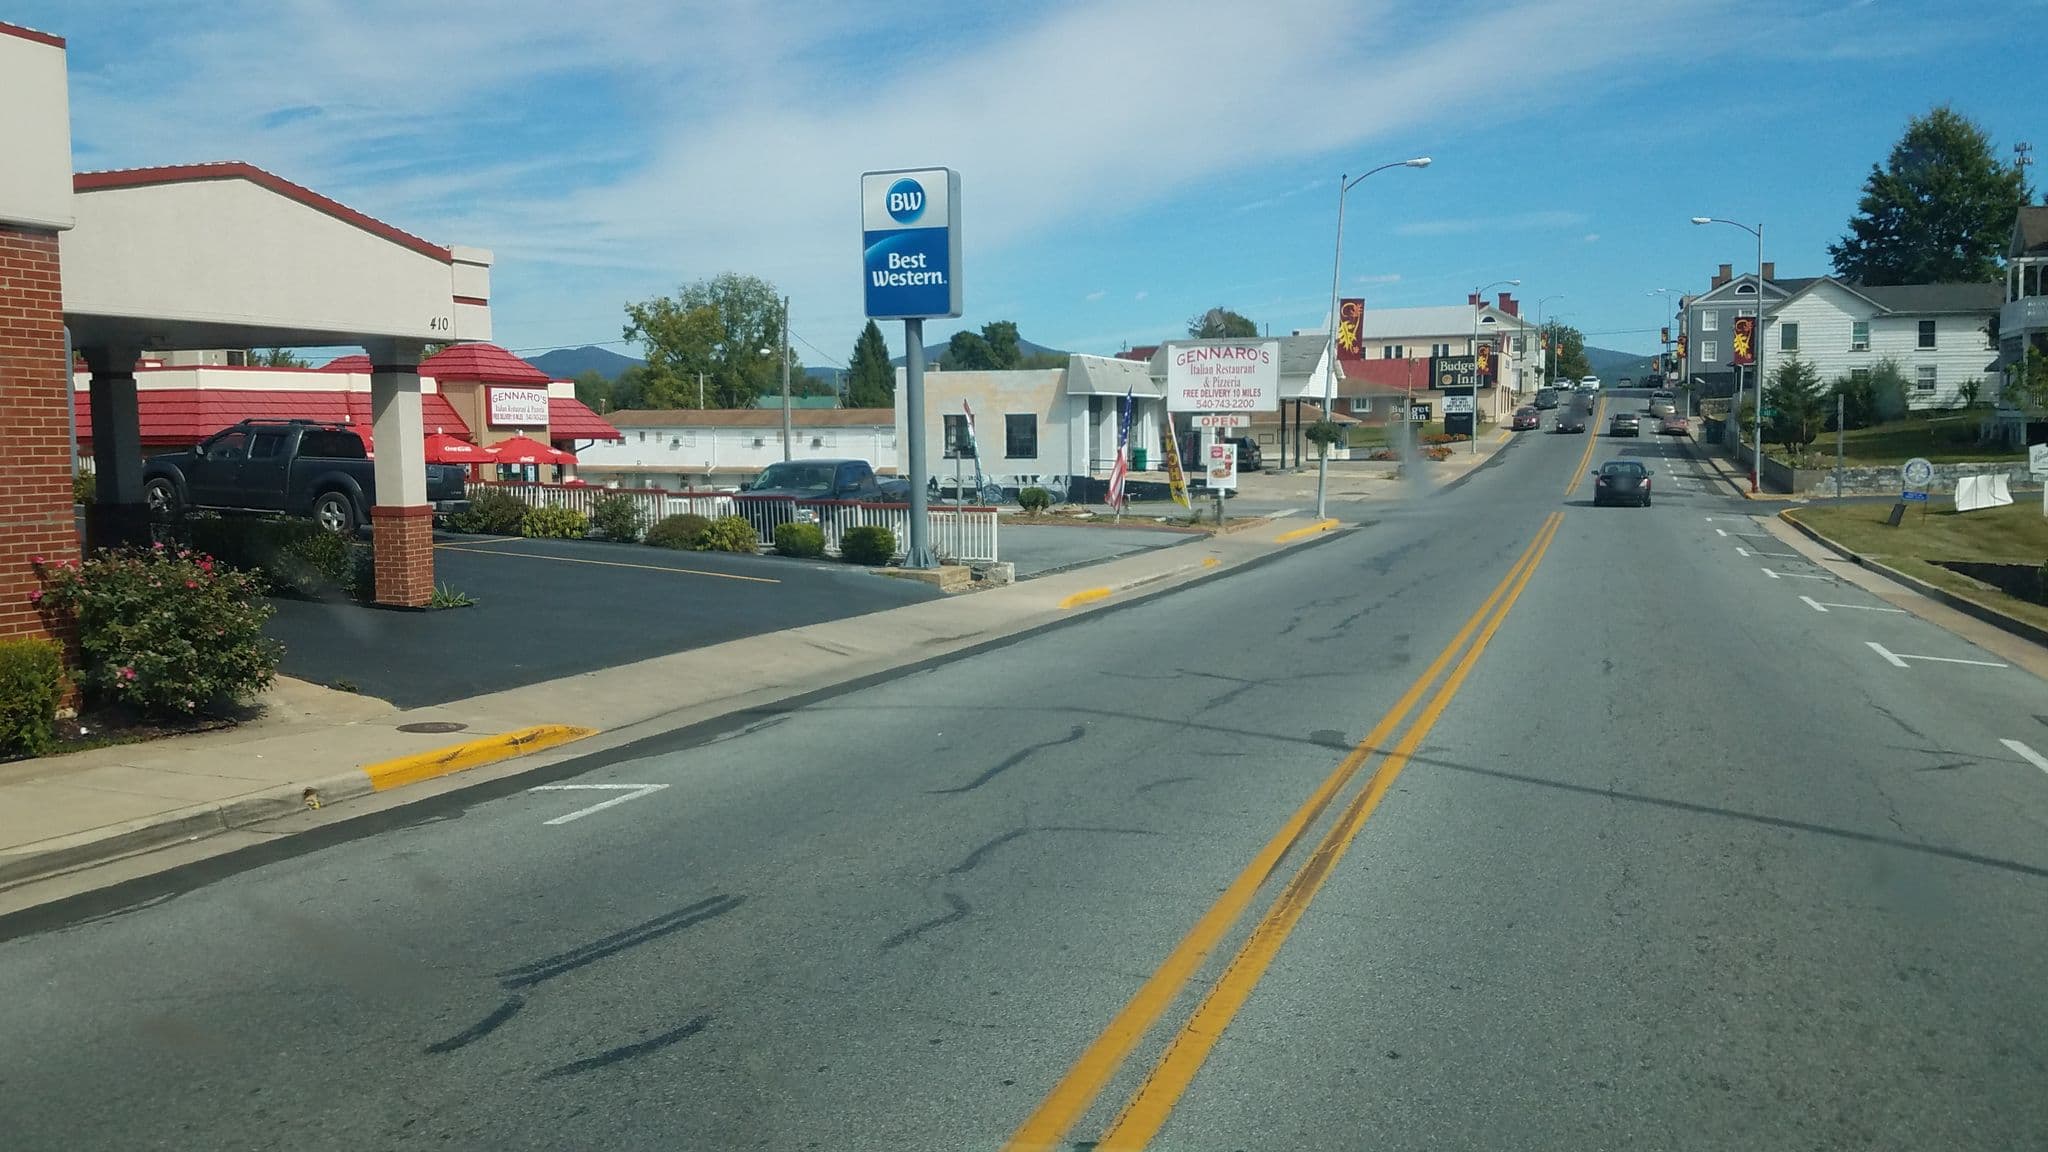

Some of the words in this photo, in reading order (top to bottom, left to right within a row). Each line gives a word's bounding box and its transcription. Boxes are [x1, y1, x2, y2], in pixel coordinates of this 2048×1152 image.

[890, 192, 922, 212] BW
[888, 253, 926, 269] Best
[872, 271, 943, 287] Western
[430, 317, 449, 331] 410
[1176, 346, 1270, 366] GENNARO'S
[1190, 364, 1214, 375] Italian
[1216, 364, 1256, 375] Restaurant
[1440, 360, 1475, 374] Budge
[1203, 378, 1210, 388] &
[1213, 376, 1241, 388] Pizzeria
[492, 391, 547, 405] GENNARO'S
[1183, 389, 1199, 398] FREE
[1200, 389, 1231, 398] DELIVERY
[1233, 389, 1241, 397] 10
[1242, 388, 1262, 397] MILES
[1196, 400, 1255, 409] 540-743-2200
[1201, 416, 1239, 426] OPEN
